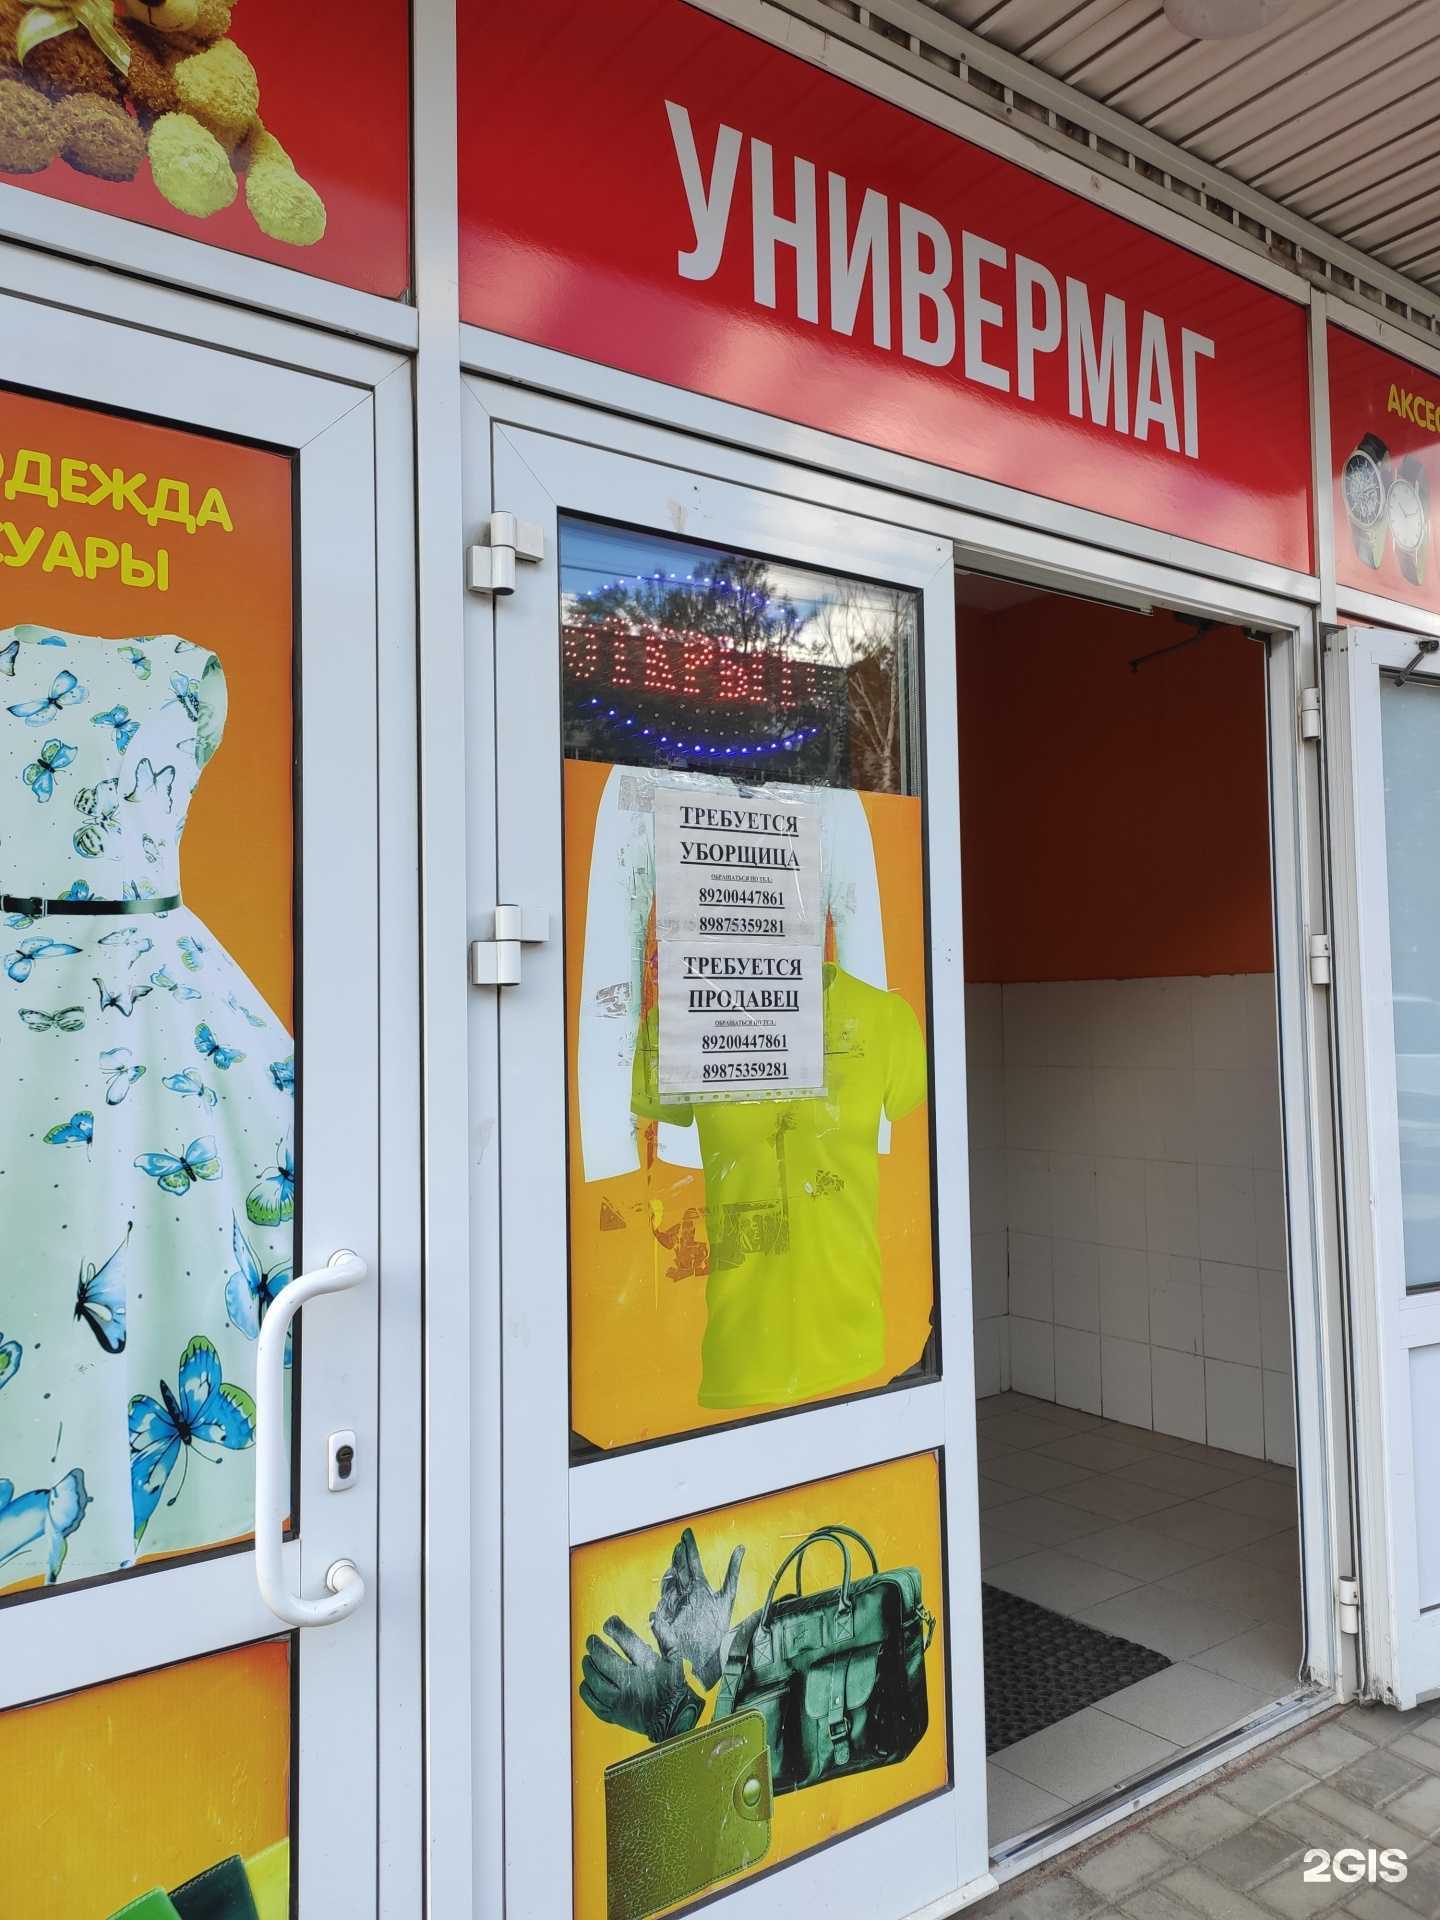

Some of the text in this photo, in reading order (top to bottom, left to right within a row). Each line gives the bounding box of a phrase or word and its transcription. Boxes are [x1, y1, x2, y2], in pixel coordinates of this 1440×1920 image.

[665, 100, 1216, 459] УНИВЕРМАГ
[0, 448, 234, 535] ДЕЖДА
[0, 521, 169, 592] УАРЫ
[680, 806, 799, 834] ТРЕБУЕТСЯ
[680, 841, 800, 868] УБОРЩИЦА
[700, 887, 784, 906] 89200447861
[700, 916, 785, 934] 89875359281
[684, 956, 802, 976] ТРЕБУЕТСЯ
[689, 989, 800, 1011] ПРОДАВЕЦ
[702, 1034, 787, 1050] 89200447861
[703, 1062, 788, 1079] 89875359281
